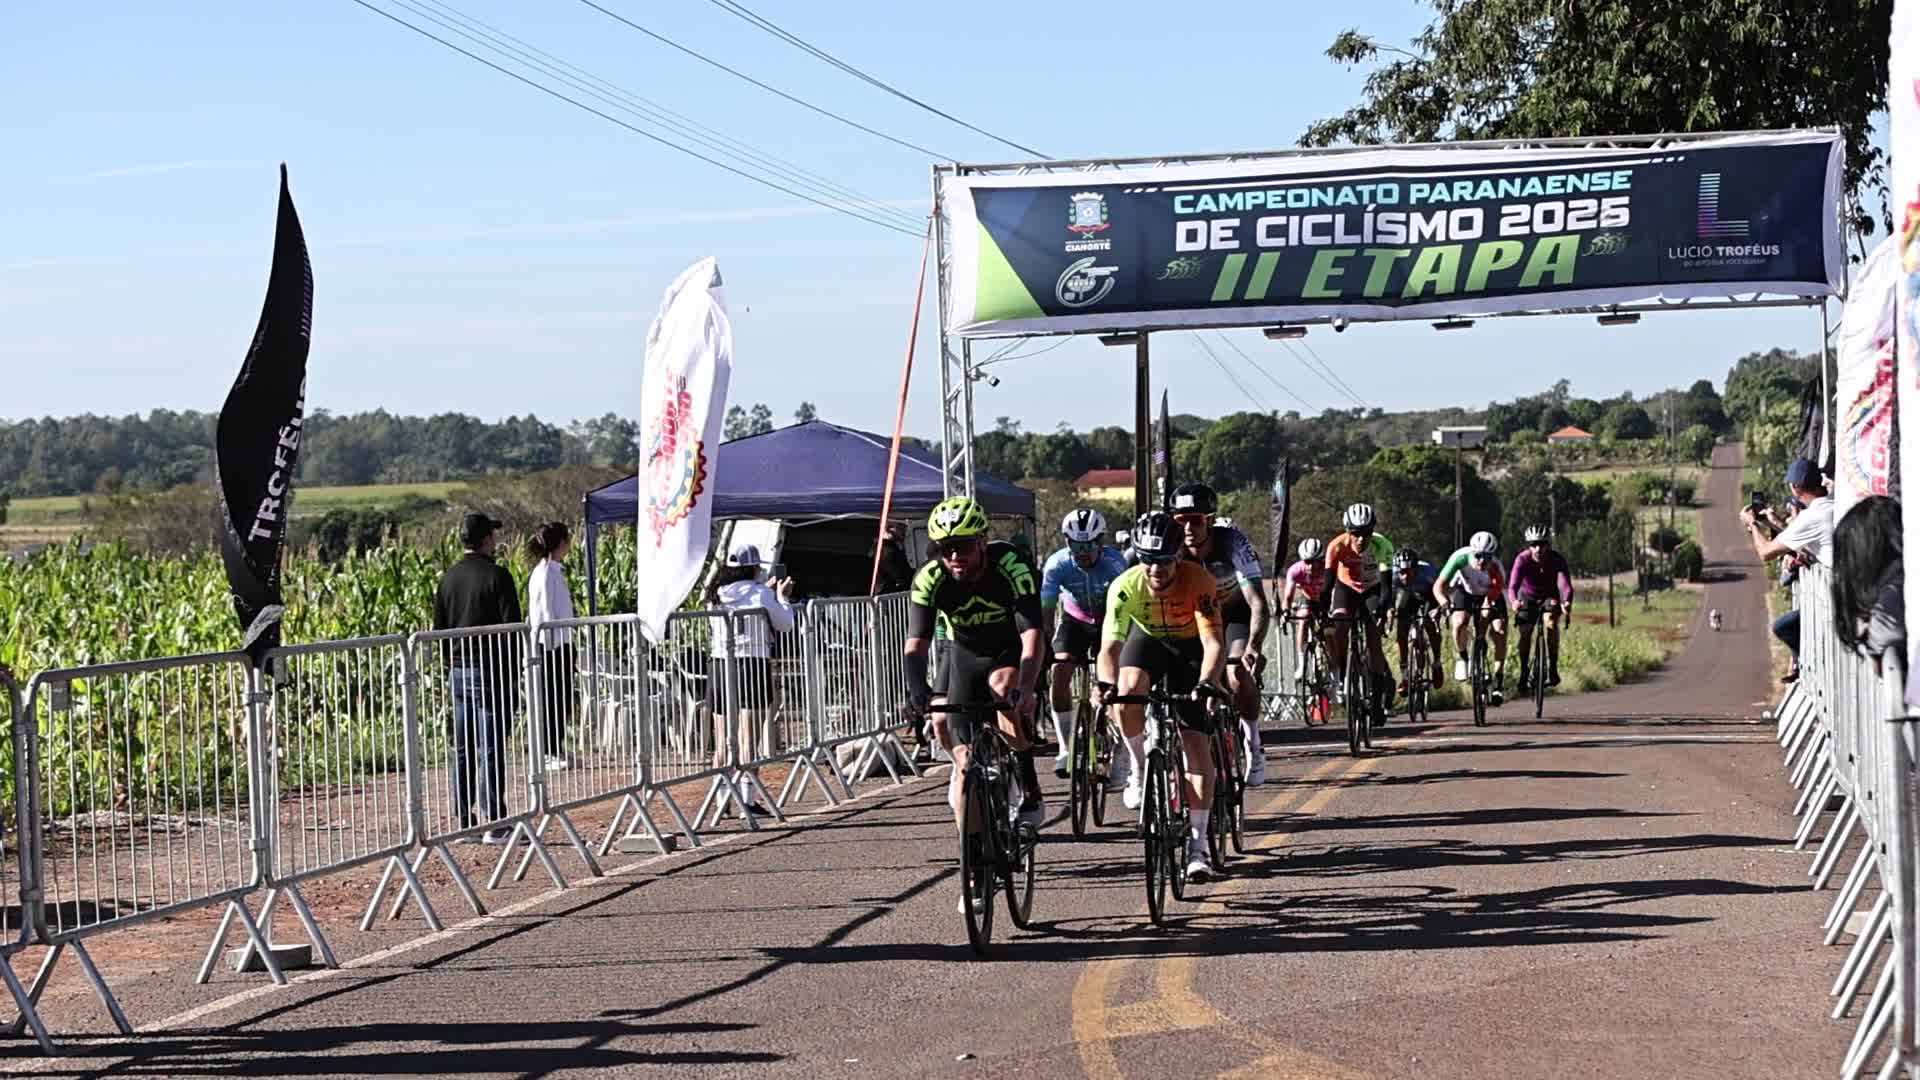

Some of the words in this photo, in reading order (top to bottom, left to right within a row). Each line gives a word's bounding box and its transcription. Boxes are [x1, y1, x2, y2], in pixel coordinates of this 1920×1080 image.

[1174, 183, 1400, 213] CAMPEONATO
[1409, 170, 1633, 205] PARANAENSE
[1175, 218, 1241, 252] DE
[1256, 203, 1484, 248] CICLÍSMO
[1499, 196, 1631, 236] 2025
[1065, 243, 1111, 252] CIANORTE
[1211, 252, 1281, 301] II
[1301, 234, 1581, 299] ETAPA
[1668, 245, 1713, 259] LUCIO
[1716, 243, 1780, 256] TROFÉUS
